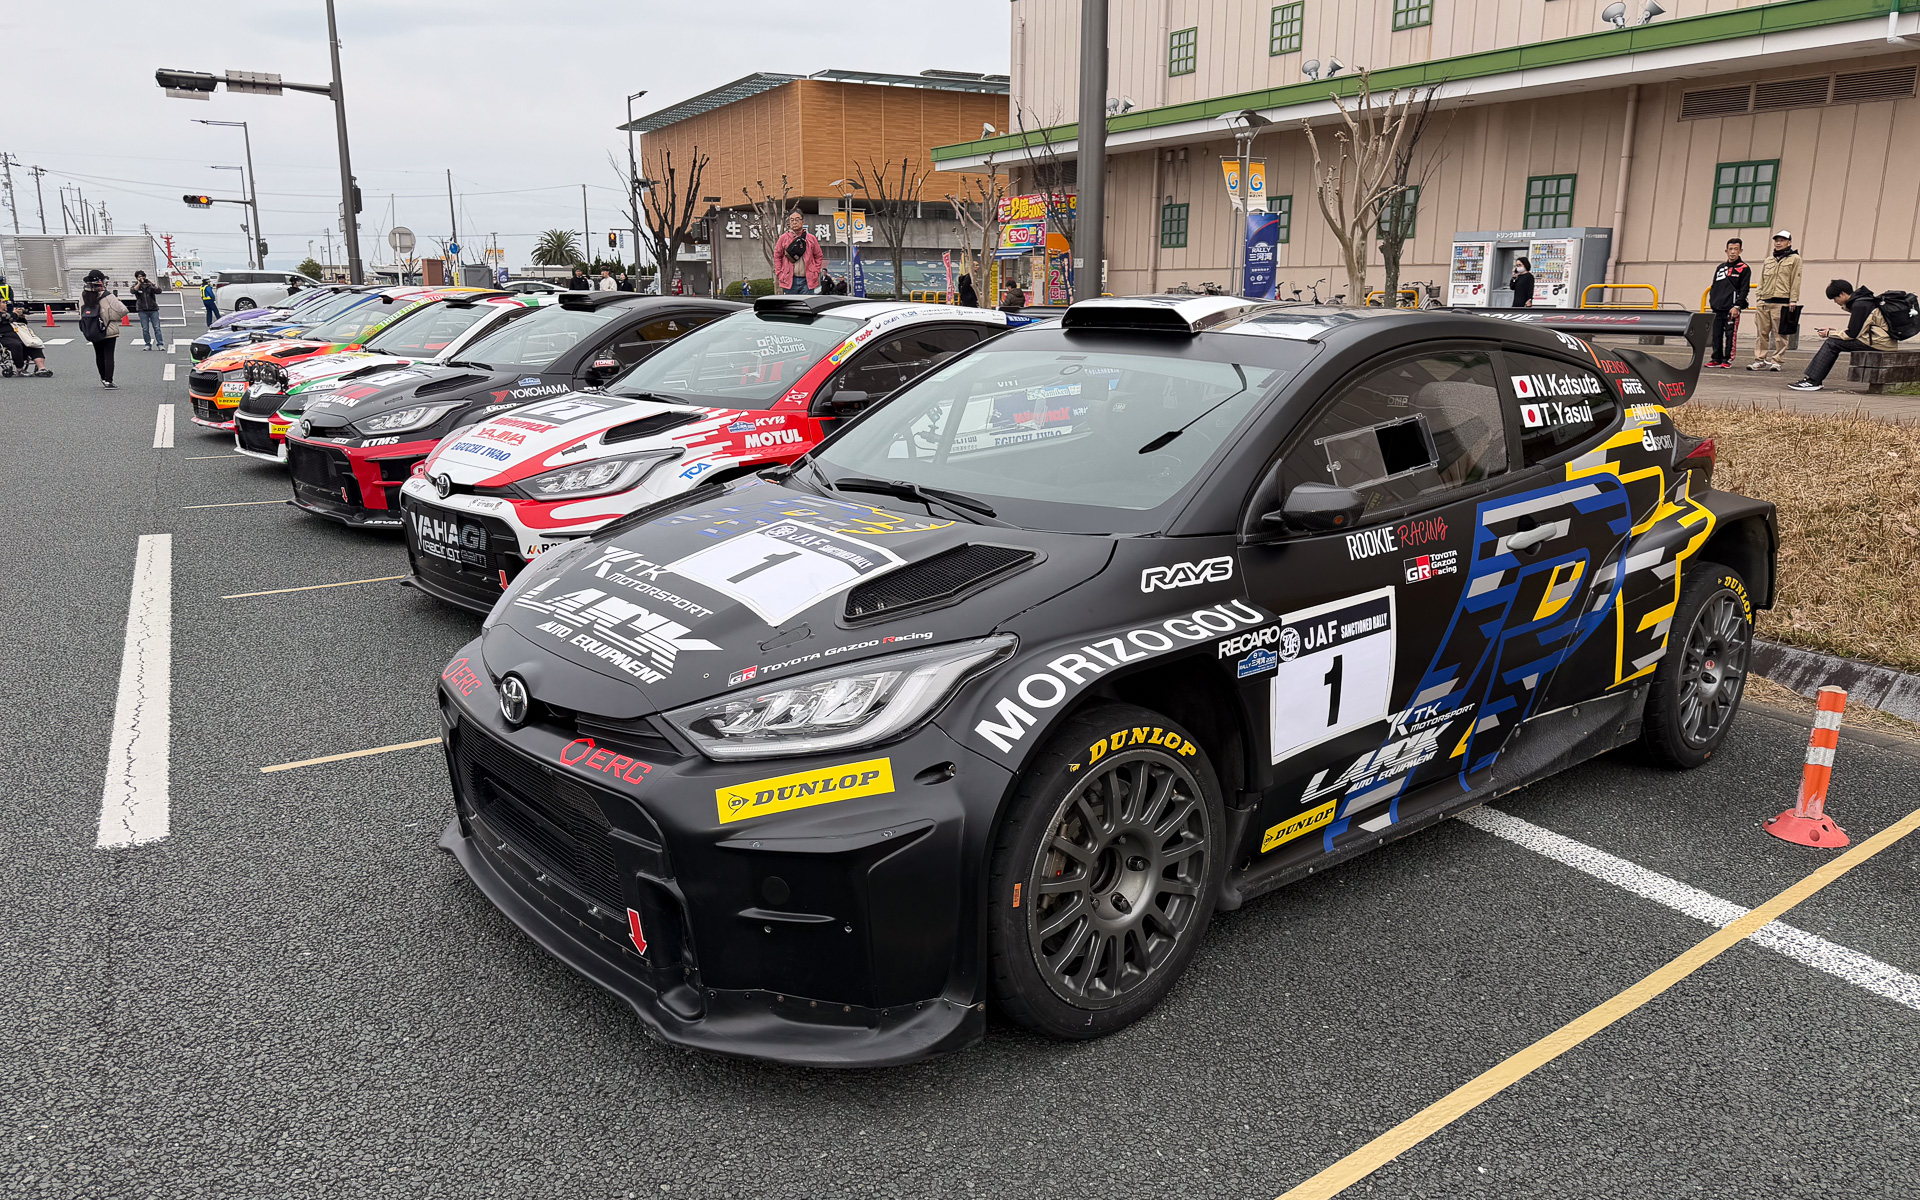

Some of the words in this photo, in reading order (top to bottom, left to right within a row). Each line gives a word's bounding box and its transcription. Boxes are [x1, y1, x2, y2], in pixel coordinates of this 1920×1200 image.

[380, 310, 405, 327] THREE
[403, 301, 419, 314] FIVE
[768, 343, 806, 355] S.Azuma
[1600, 359, 1630, 374] DENSO
[509, 383, 571, 399] YOKOHAMA
[1531, 373, 1601, 398] N.Katsuta
[320, 393, 360, 408] ADVAN
[1387, 396, 1408, 406] OMP
[1539, 400, 1594, 426] T.Yasui
[755, 415, 786, 427] KYB
[360, 435, 401, 449] KTMS
[745, 428, 804, 449] MOTUL
[788, 532, 829, 548] JAF
[1345, 526, 1398, 561] ROOKIE
[1397, 516, 1448, 548] RACING
[726, 551, 803, 584] 1
[1429, 549, 1458, 562] TOYOTA
[1430, 558, 1457, 569] GAZOO
[624, 559, 672, 582] TK
[1140, 555, 1233, 593] RAYS
[1406, 564, 1431, 582] GR
[1432, 565, 1458, 576] Racing
[606, 572, 714, 618] MOTORSPORT
[1724, 576, 1753, 625] DUNLOP
[1218, 625, 1280, 660] RECARO
[1304, 619, 1338, 650] JAF
[1340, 617, 1373, 639] SANCTIONED
[1372, 612, 1388, 630] RALLY
[535, 621, 573, 639] AUTO
[569, 633, 667, 685] EQUIPMENT
[728, 668, 757, 686] GR
[760, 652, 821, 674] TOYOTA
[824, 639, 880, 656] GAZOO
[882, 631, 934, 645] Racing
[451, 666, 483, 697] ERC
[1324, 654, 1343, 727] 1
[1409, 702, 1476, 733] MOTORSPORT
[1413, 701, 1442, 723] TK
[1088, 726, 1197, 765] DUNLOP
[584, 747, 653, 785] ERC
[1344, 778, 1374, 796] AUTO
[1377, 749, 1438, 782] EQUIPMENT
[752, 770, 880, 807] DUNLOP
[1273, 806, 1335, 842] DUNLOP
